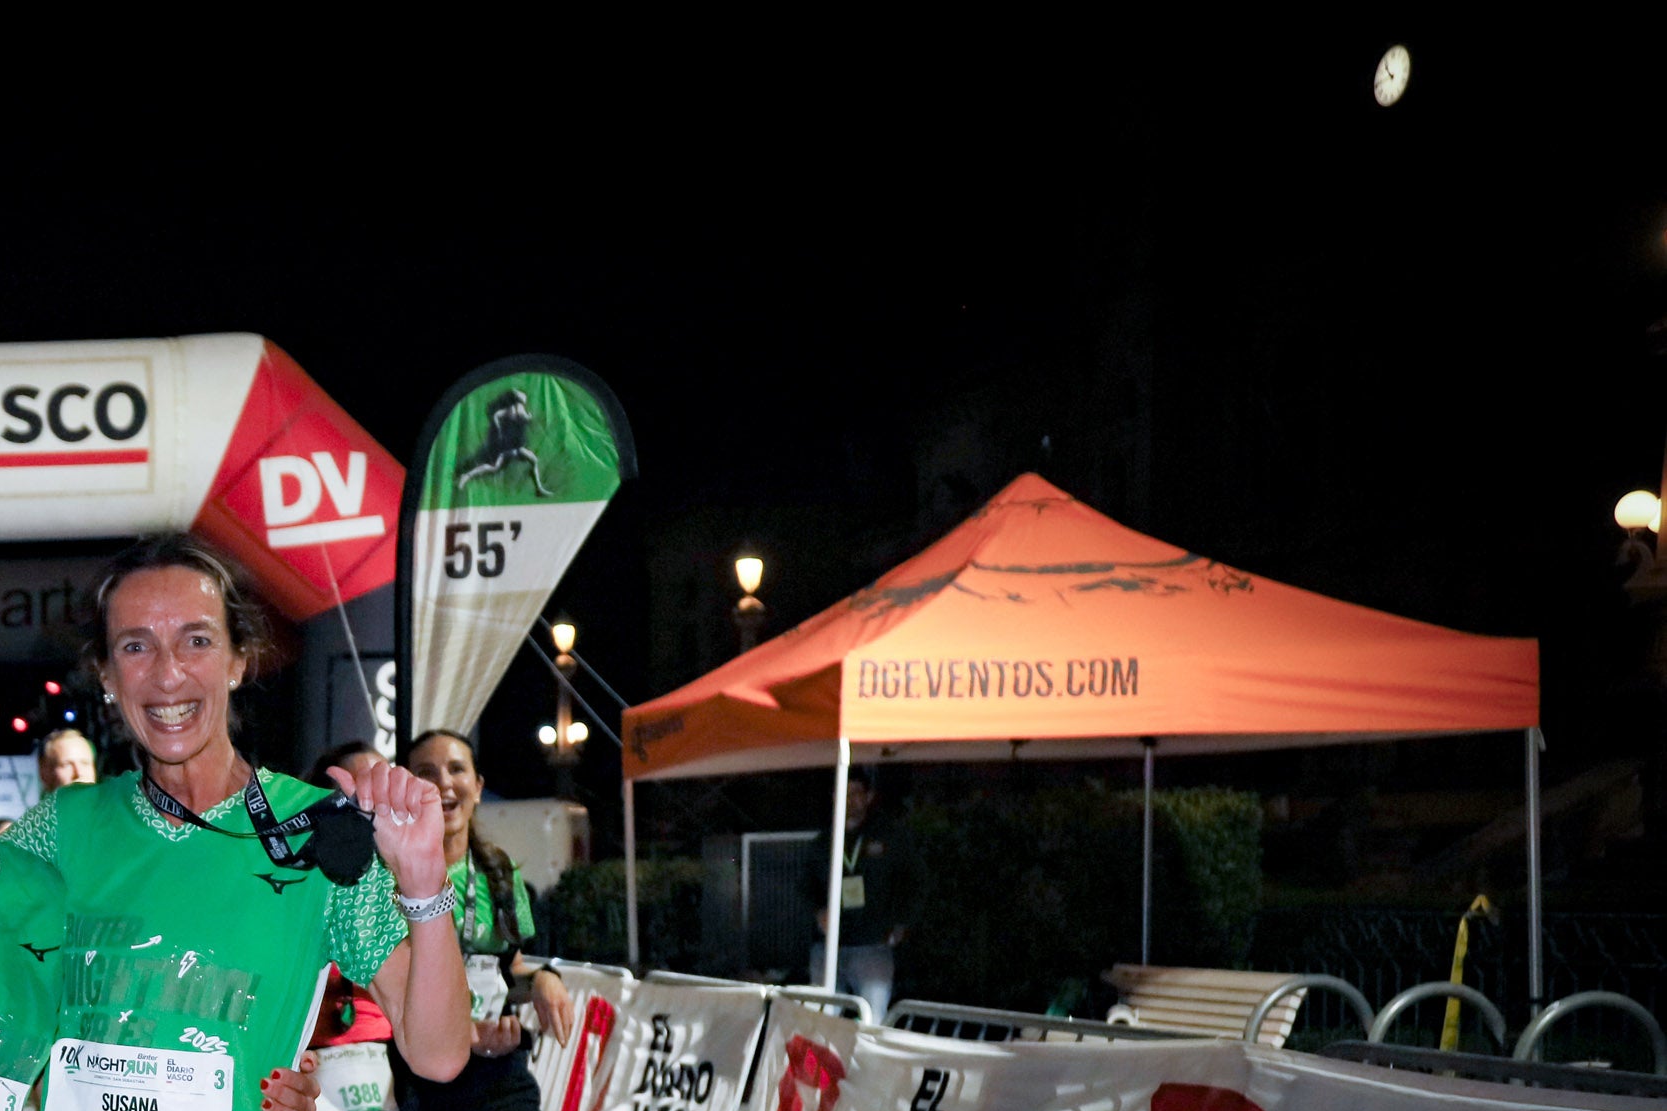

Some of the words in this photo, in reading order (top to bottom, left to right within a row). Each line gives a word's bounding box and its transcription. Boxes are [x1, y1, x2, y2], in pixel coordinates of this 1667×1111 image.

[259, 451, 366, 527] DV
[857, 656, 1140, 700] DGEVENTOS.COM
[179, 1028, 230, 1055] 2025
[59, 1045, 84, 1069] 10K
[137, 1053, 158, 1062] Binter
[166, 1065, 194, 1074] DIARIO
[214, 1069, 225, 1090] 3
[337, 1082, 382, 1108] 1388
